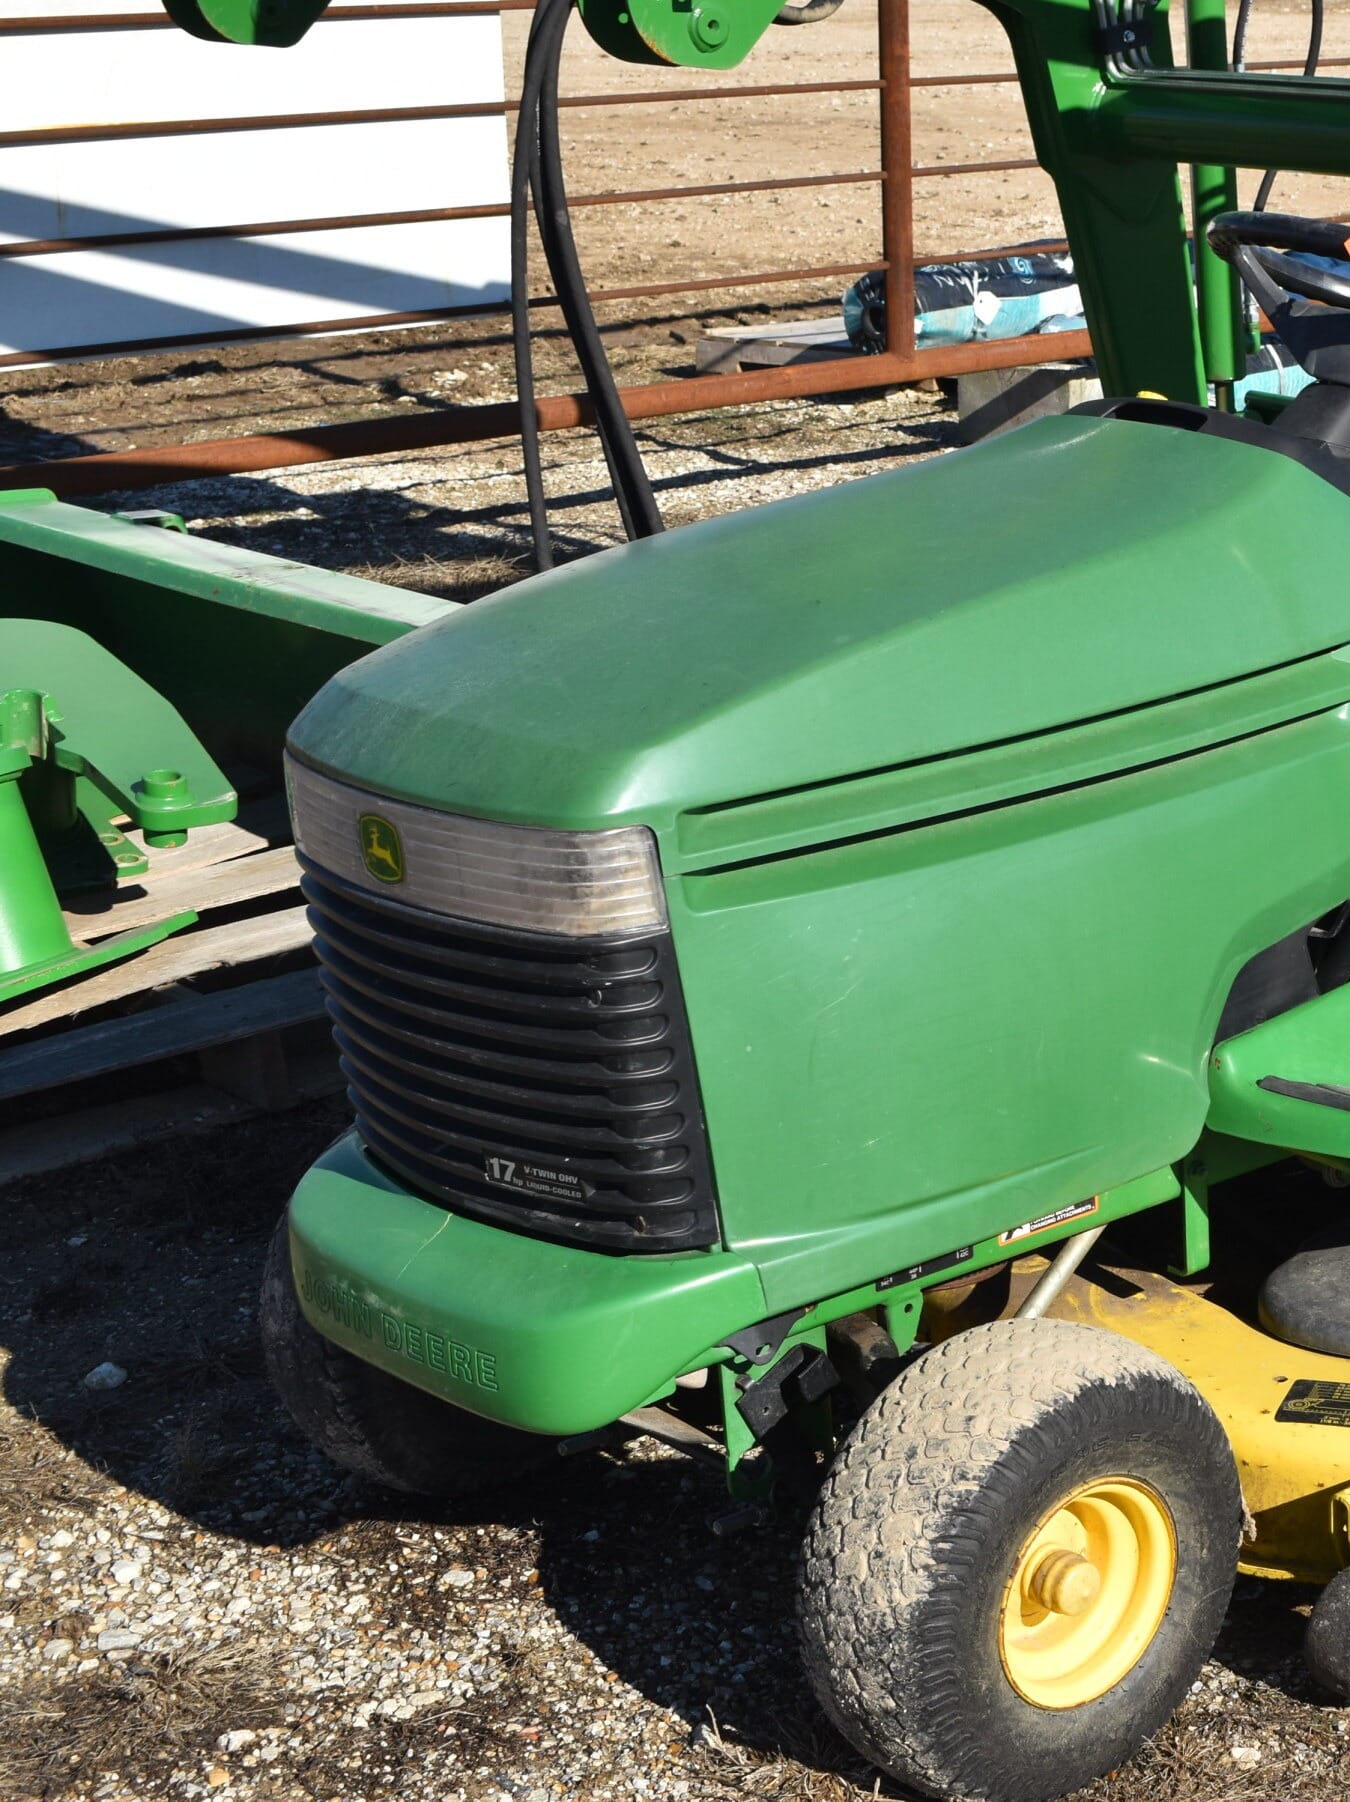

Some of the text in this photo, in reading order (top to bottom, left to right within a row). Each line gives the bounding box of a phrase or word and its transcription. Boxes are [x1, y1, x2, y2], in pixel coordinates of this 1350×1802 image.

[490, 1157, 523, 1186] 17 hp
[523, 1166, 578, 1185] V-TWIN OHV
[302, 1271, 499, 1392] JOHN DEERE
